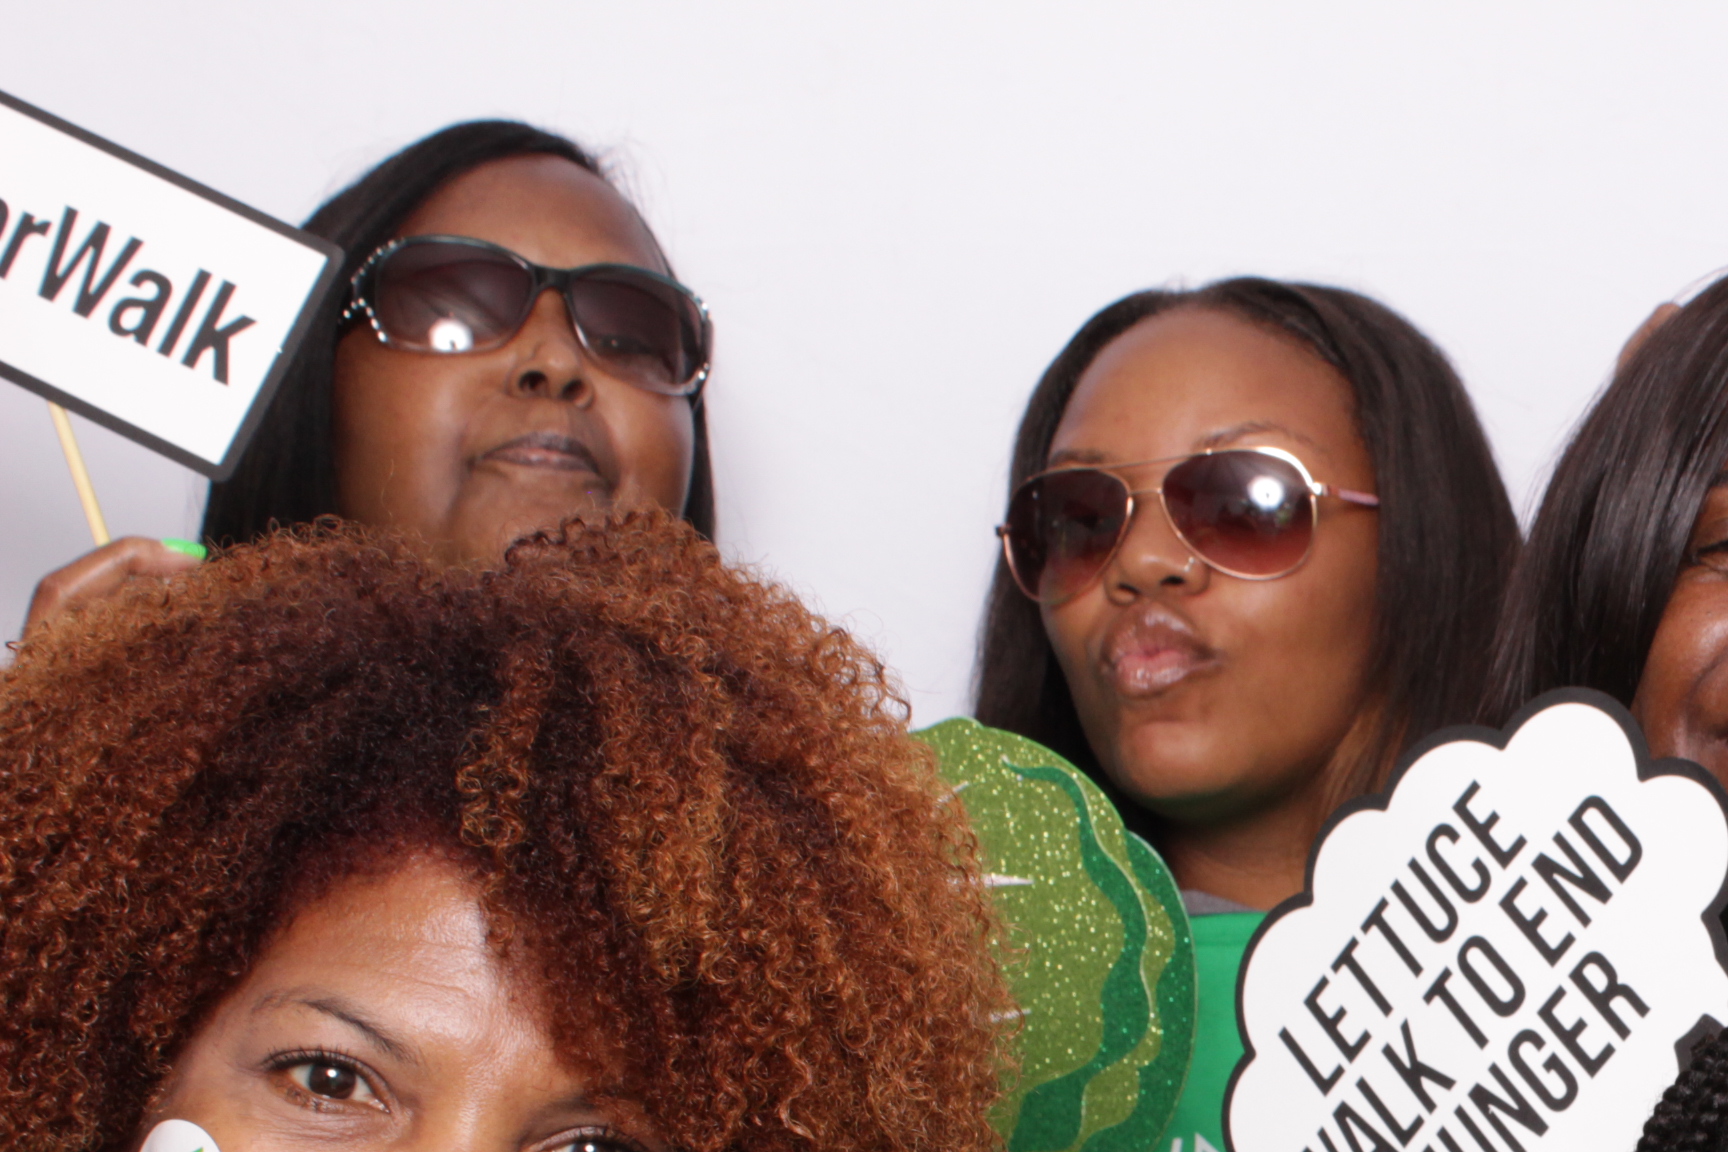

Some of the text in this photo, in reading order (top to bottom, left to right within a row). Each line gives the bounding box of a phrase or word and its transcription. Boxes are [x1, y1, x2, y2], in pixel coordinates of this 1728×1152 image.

[0, 197, 258, 386] rWalk
[1278, 779, 1528, 1096] LETTUCE
[1423, 935, 1526, 1050] TO
[1498, 795, 1643, 967] END
